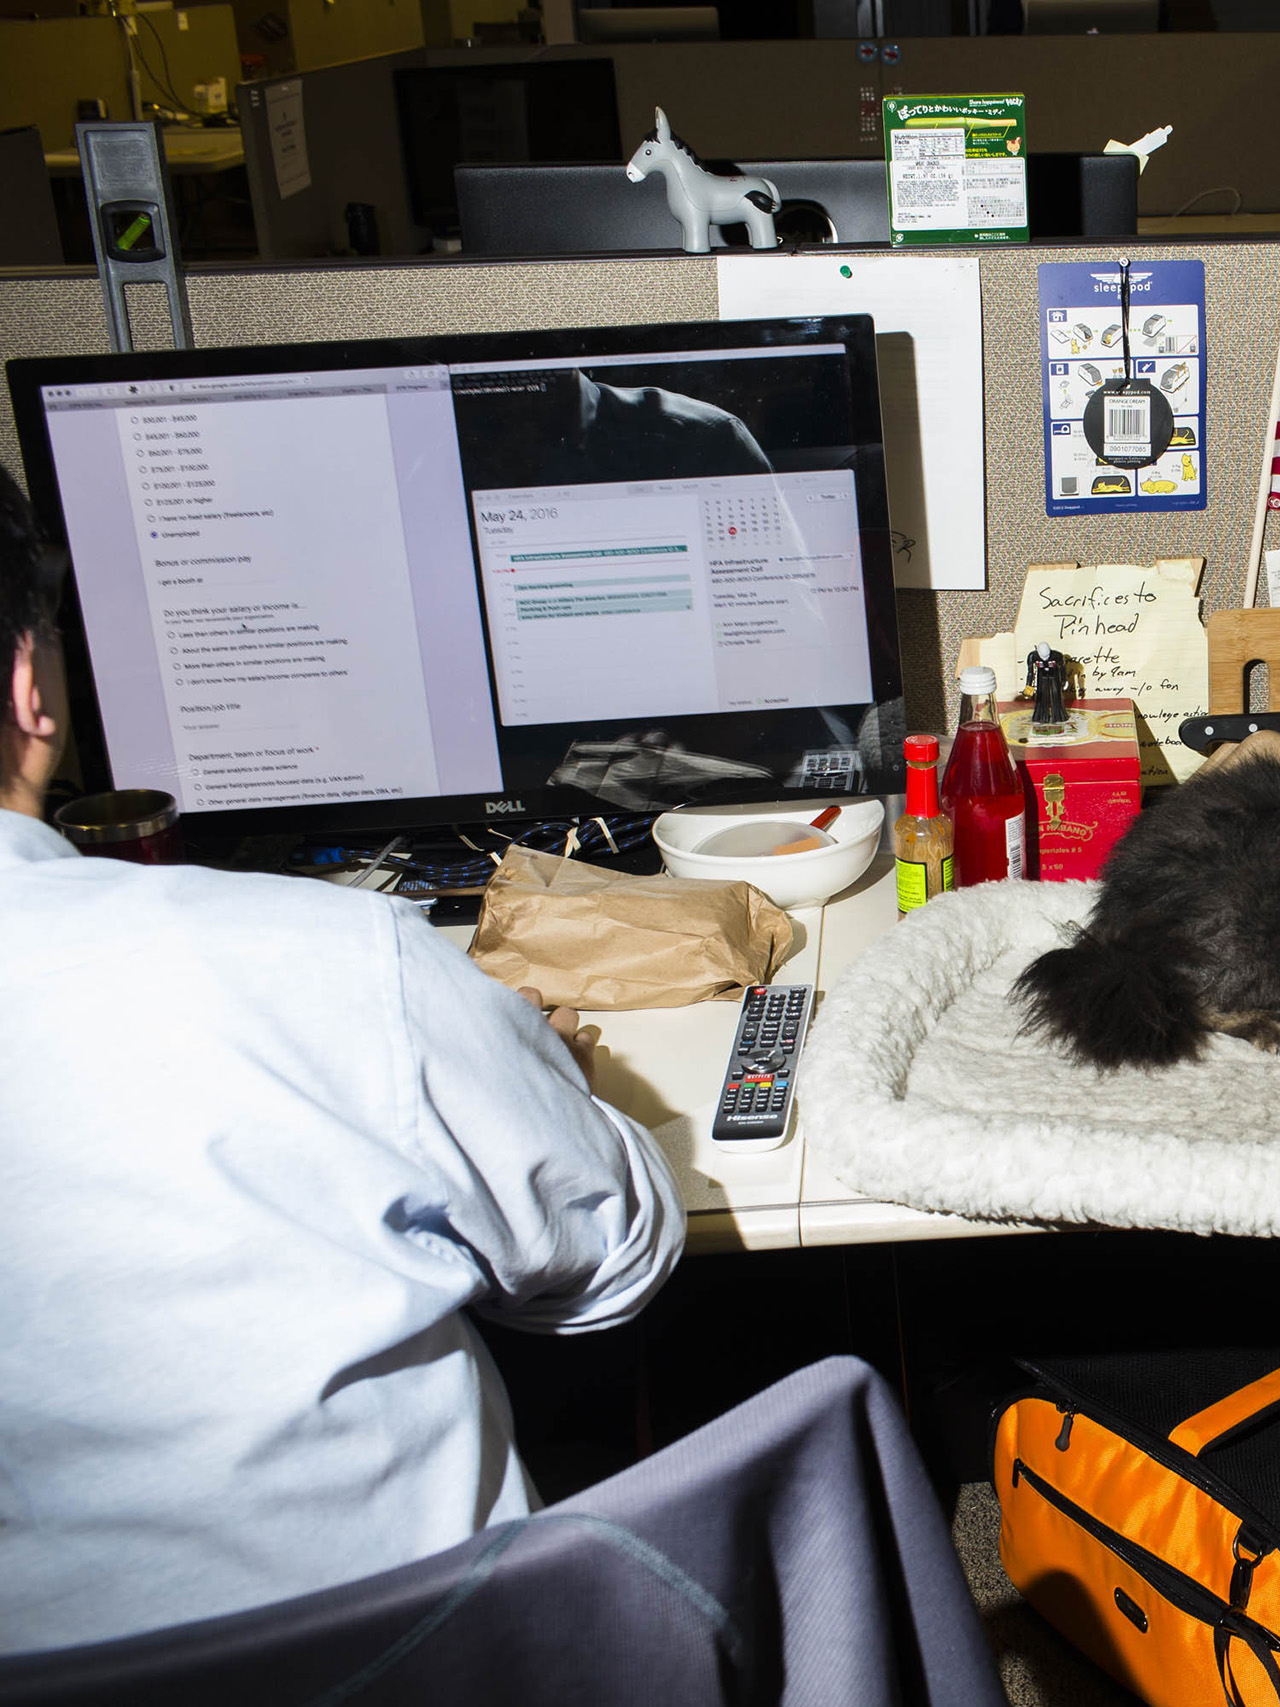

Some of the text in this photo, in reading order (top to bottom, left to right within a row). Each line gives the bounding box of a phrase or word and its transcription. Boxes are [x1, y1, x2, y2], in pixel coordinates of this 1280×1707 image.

[481, 507, 558, 524] May 24, 2016
[190, 557, 236, 565] commission
[238, 556, 252, 564] pay
[1039, 582, 1157, 610] Sacrifices to
[176, 609, 190, 618] you
[191, 606, 209, 615] think
[211, 607, 228, 616] your
[230, 605, 251, 614] salary
[262, 603, 290, 611] income
[236, 627, 256, 635] similar
[258, 626, 285, 634] positions
[298, 624, 319, 632] making
[286, 640, 314, 648] positions
[326, 638, 348, 646] making
[264, 658, 292, 666] positions
[304, 655, 326, 663] making
[189, 752, 233, 762] Department,
[486, 800, 526, 814] DELL
